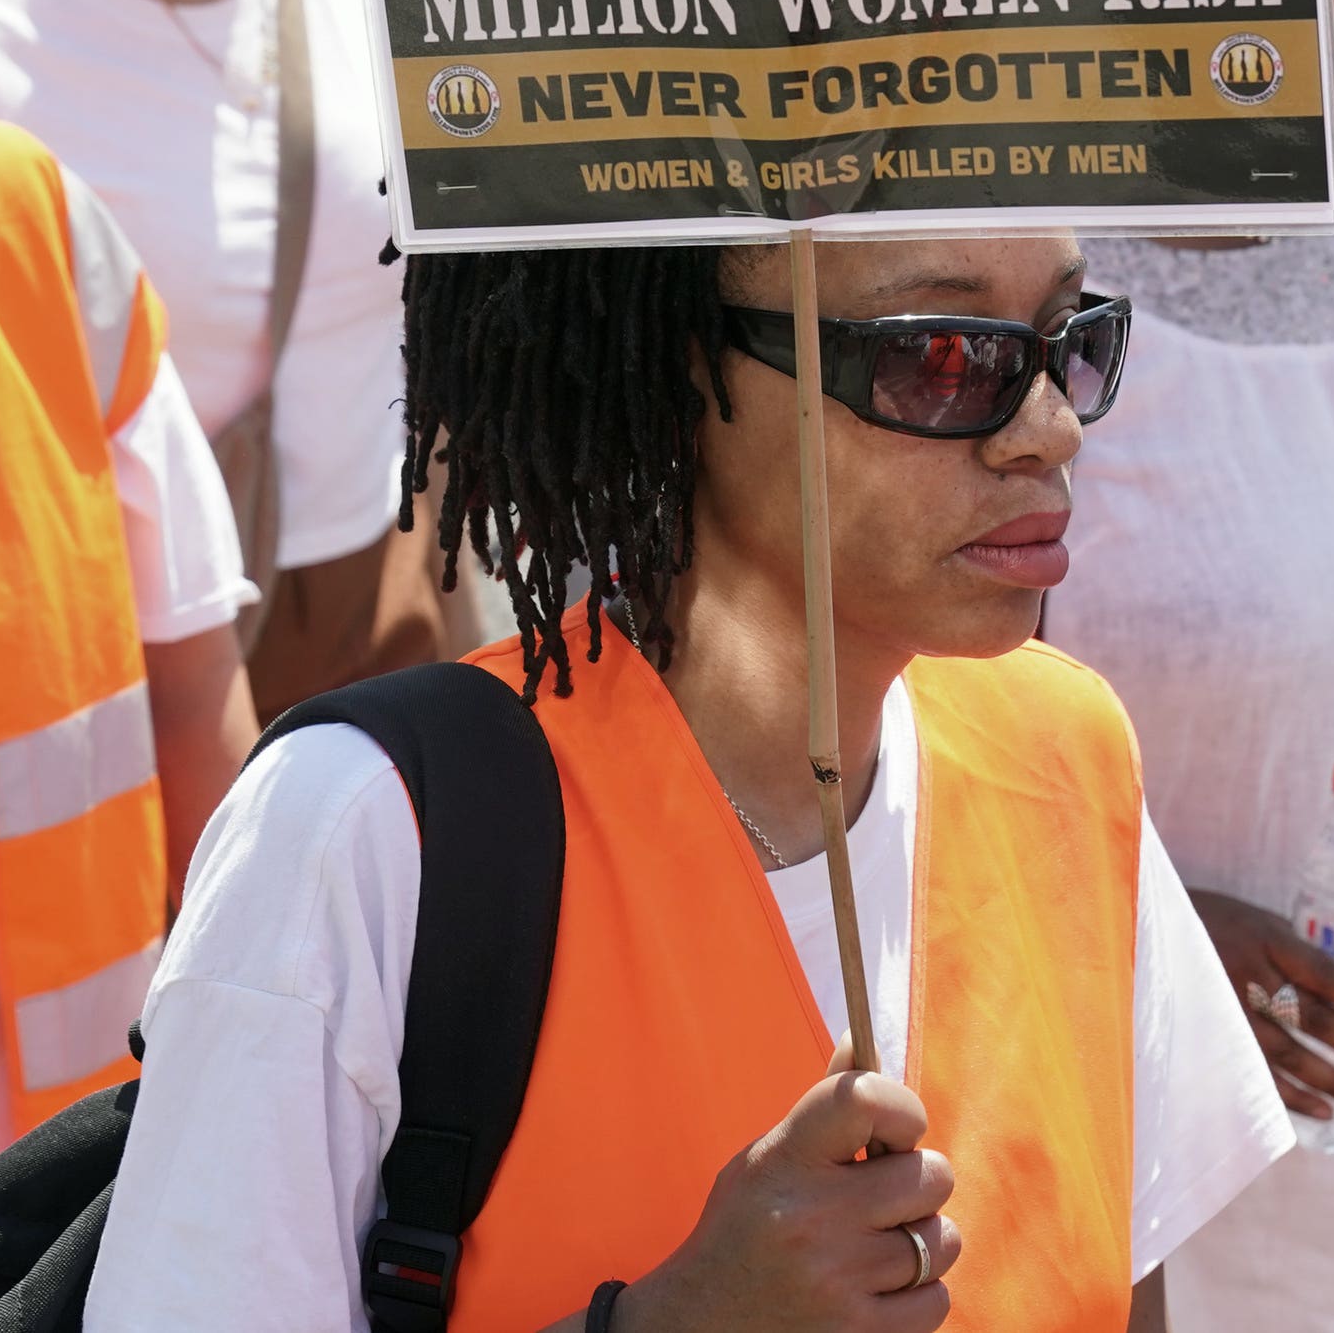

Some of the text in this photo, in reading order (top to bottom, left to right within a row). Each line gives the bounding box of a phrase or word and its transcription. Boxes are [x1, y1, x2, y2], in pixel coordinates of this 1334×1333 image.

[518, 70, 747, 123] NEVER
[767, 47, 1193, 120] FORGOTTEN
[580, 144, 1148, 193] WOMEN & GIRLS KILLED BY MEN
